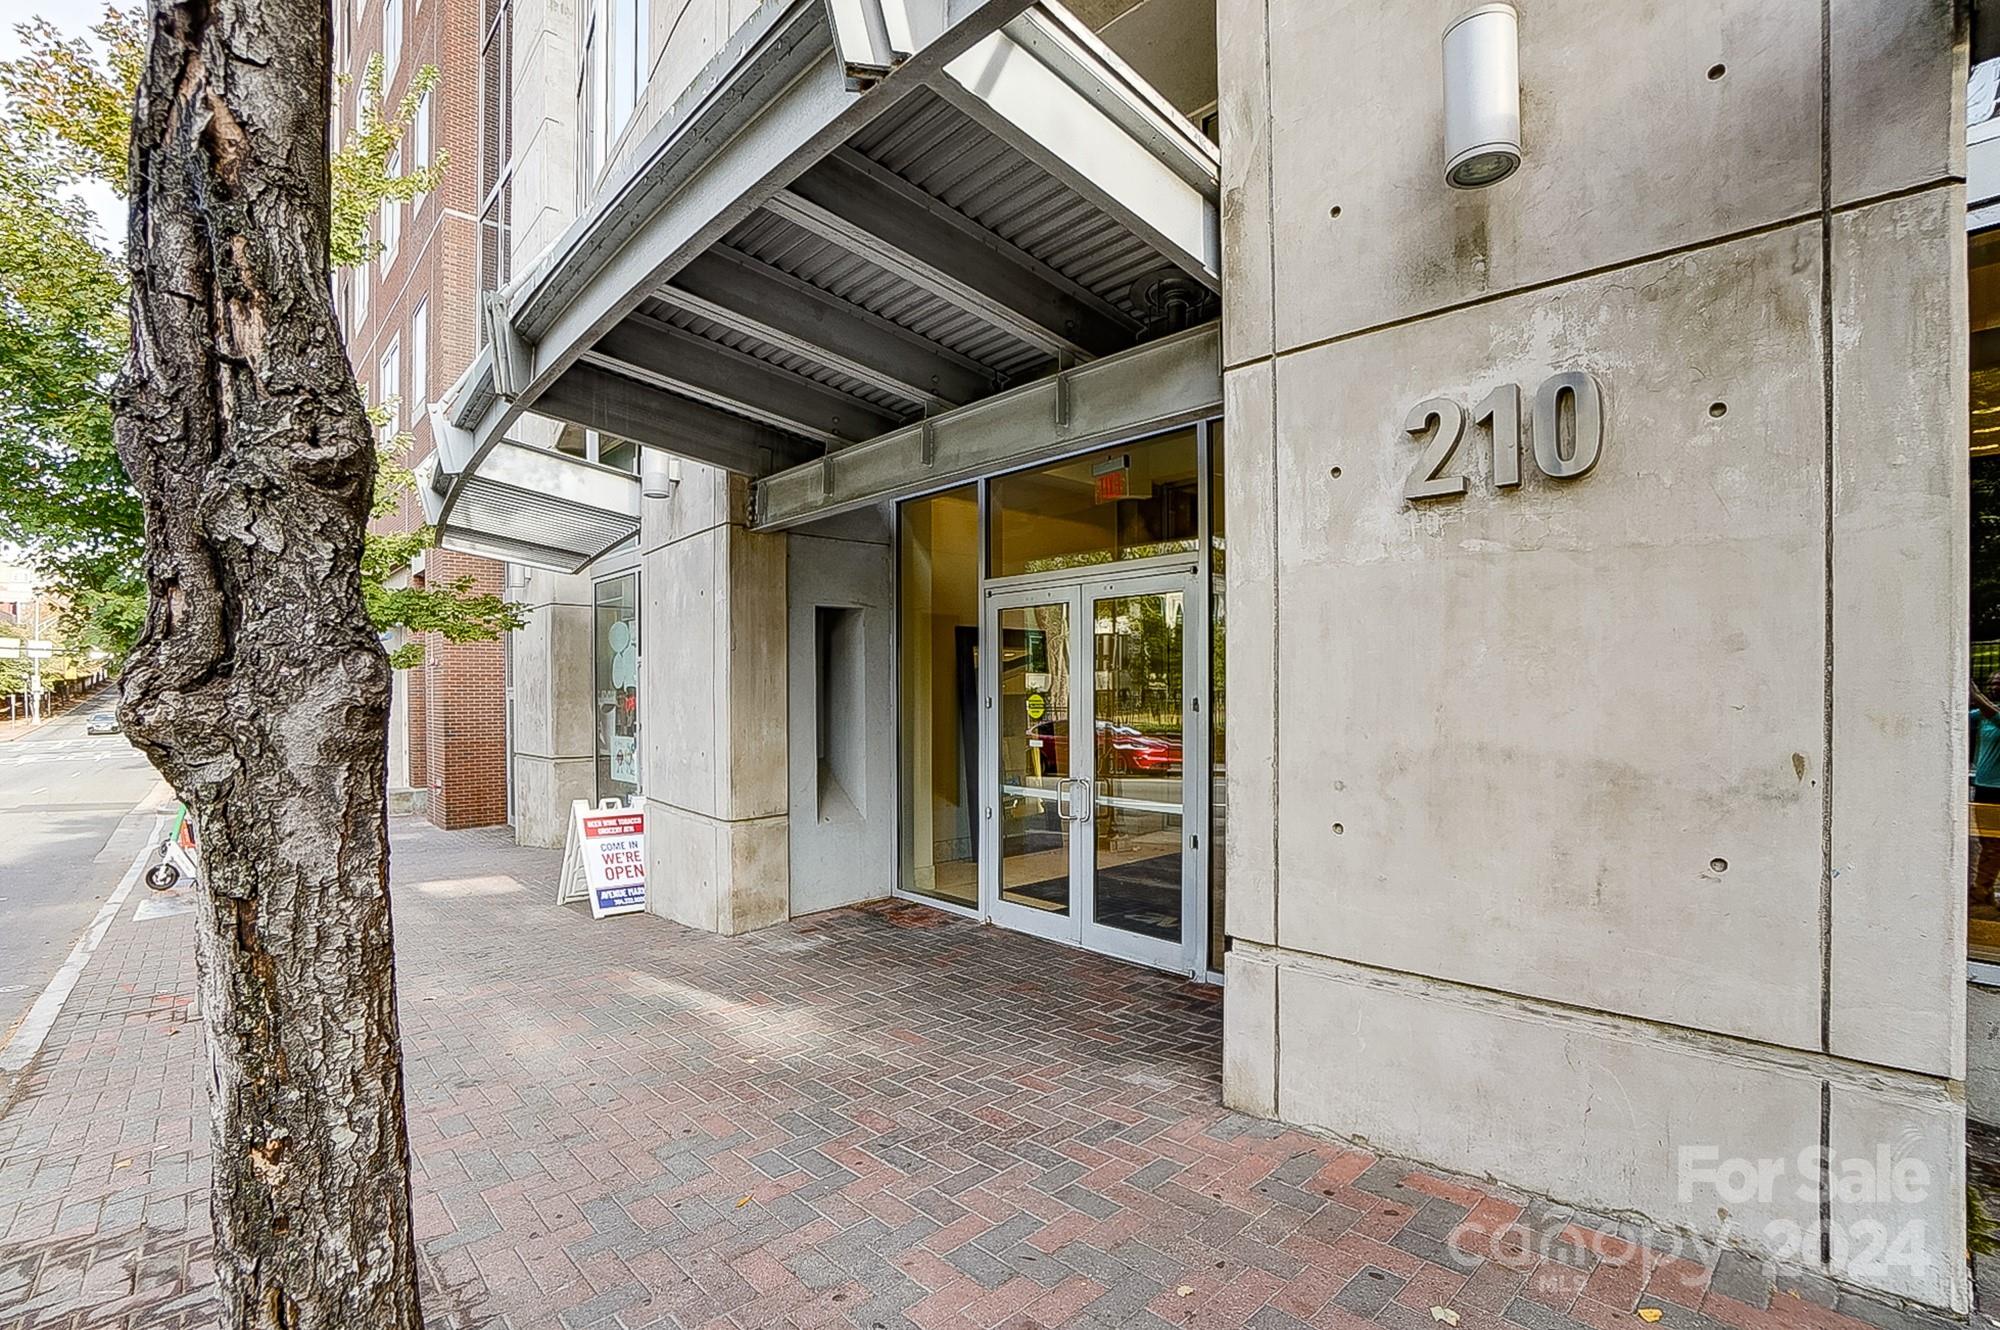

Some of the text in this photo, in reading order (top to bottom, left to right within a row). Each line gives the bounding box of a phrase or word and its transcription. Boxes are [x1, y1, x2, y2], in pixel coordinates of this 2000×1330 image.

[1402, 371, 1605, 500] 210
[600, 842, 626, 851] COME
[602, 851, 641, 864] WE'RE
[605, 864, 645, 880] OPEN
